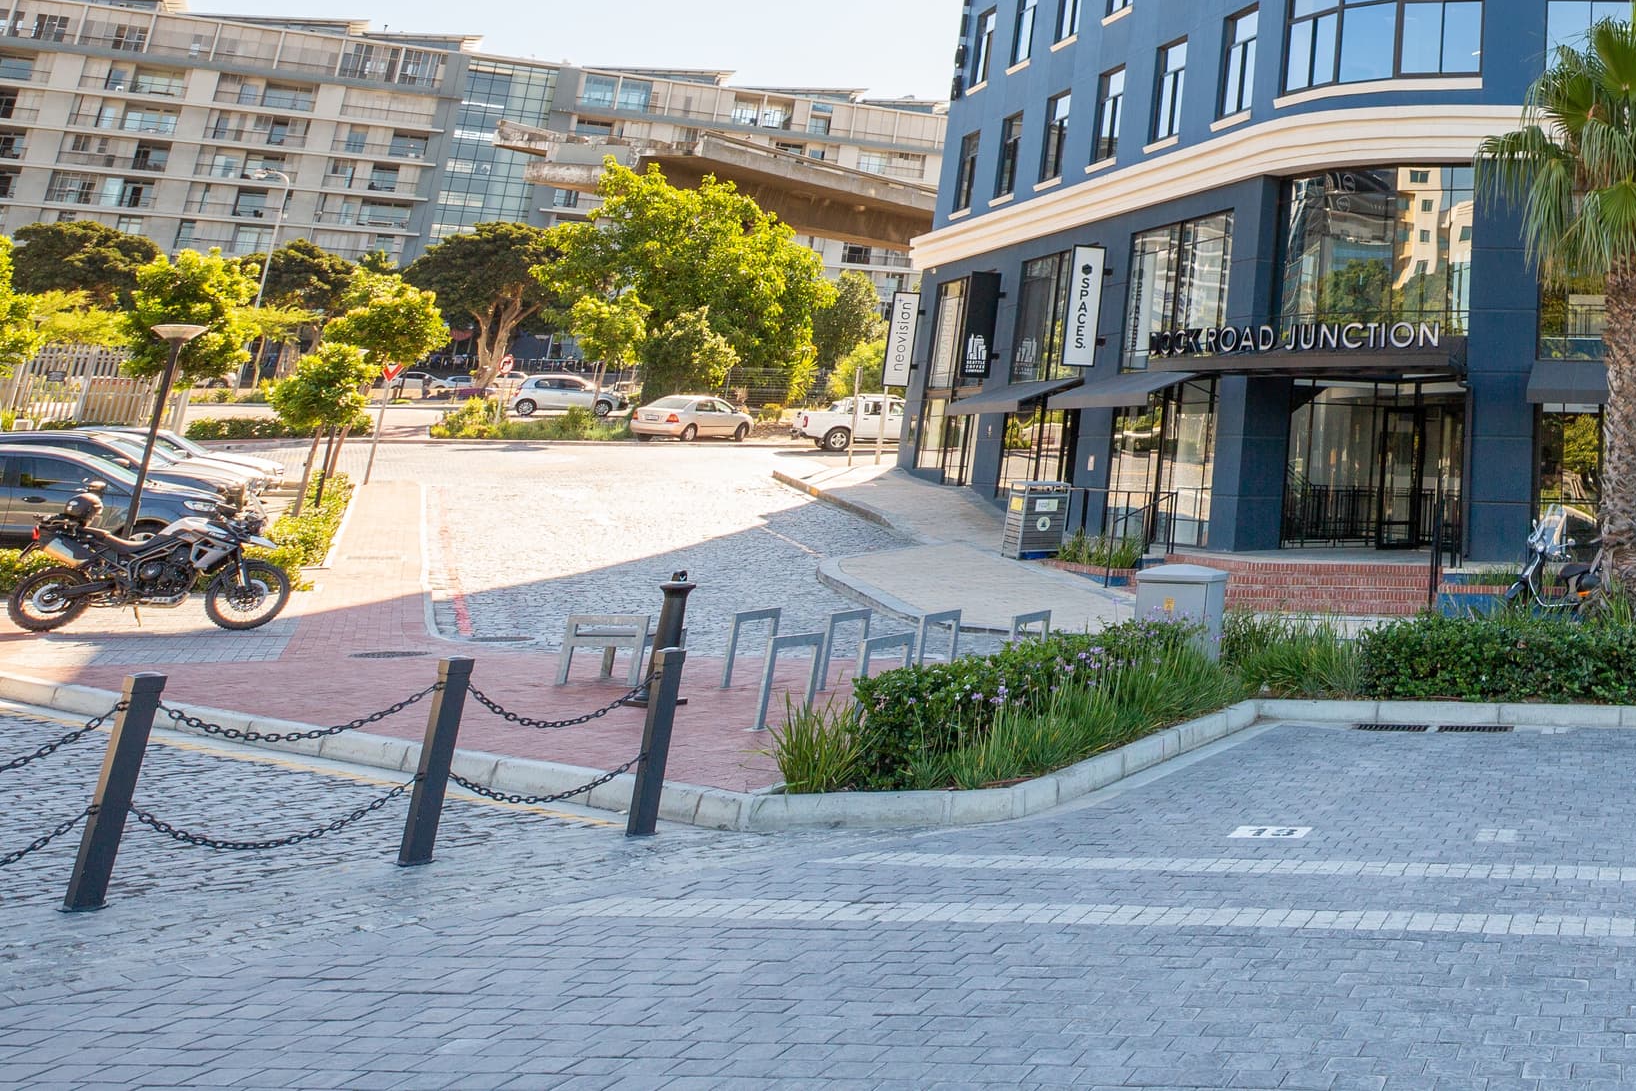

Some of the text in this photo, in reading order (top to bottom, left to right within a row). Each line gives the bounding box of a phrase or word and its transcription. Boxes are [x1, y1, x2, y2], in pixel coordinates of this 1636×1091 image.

[1074, 277, 1090, 349] SPACES.
[1206, 324, 1275, 353] ROAD
[1285, 321, 1440, 351] JUNCTION
